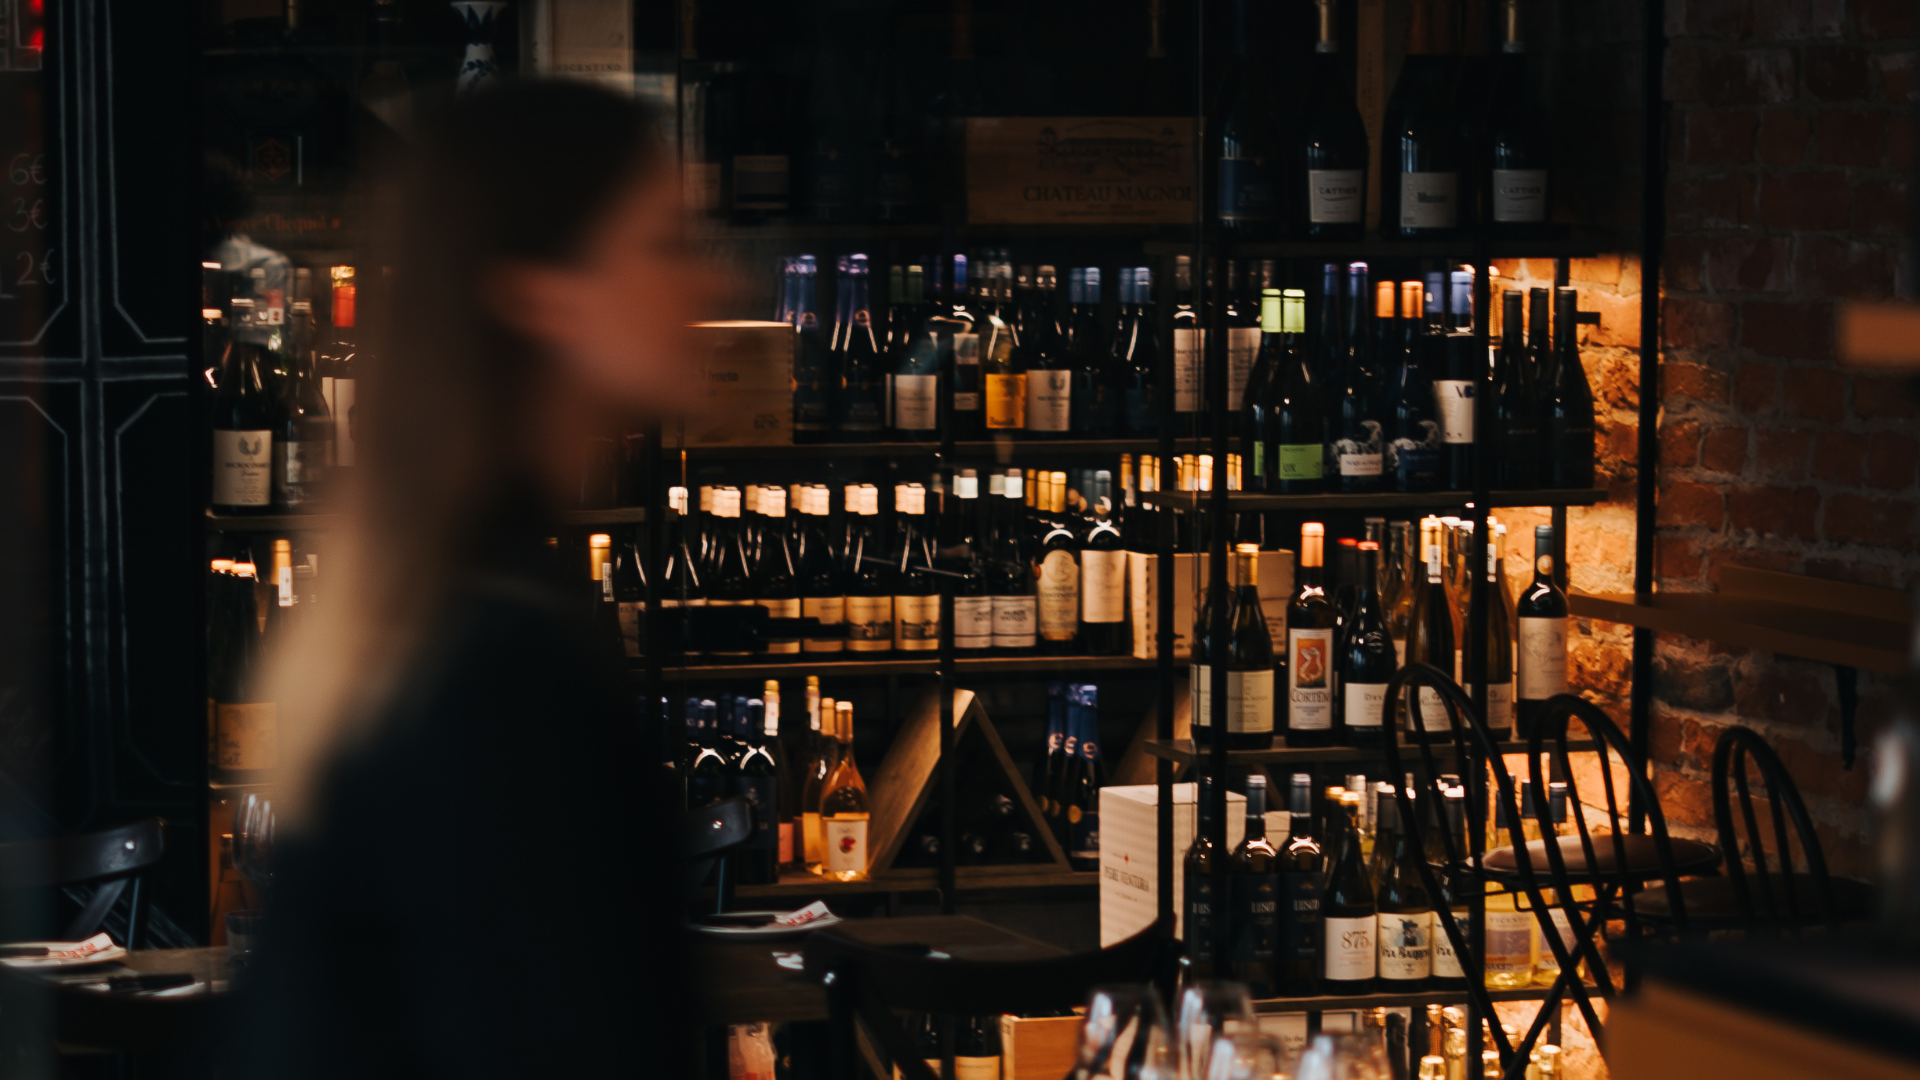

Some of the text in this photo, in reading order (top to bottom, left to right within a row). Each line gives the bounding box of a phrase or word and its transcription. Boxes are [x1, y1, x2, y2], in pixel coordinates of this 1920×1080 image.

[9, 153, 47, 185] 6€
[1023, 185, 1111, 202] CHATEAU
[7, 196, 48, 232] 3€
[15, 248, 56, 286] 2€
